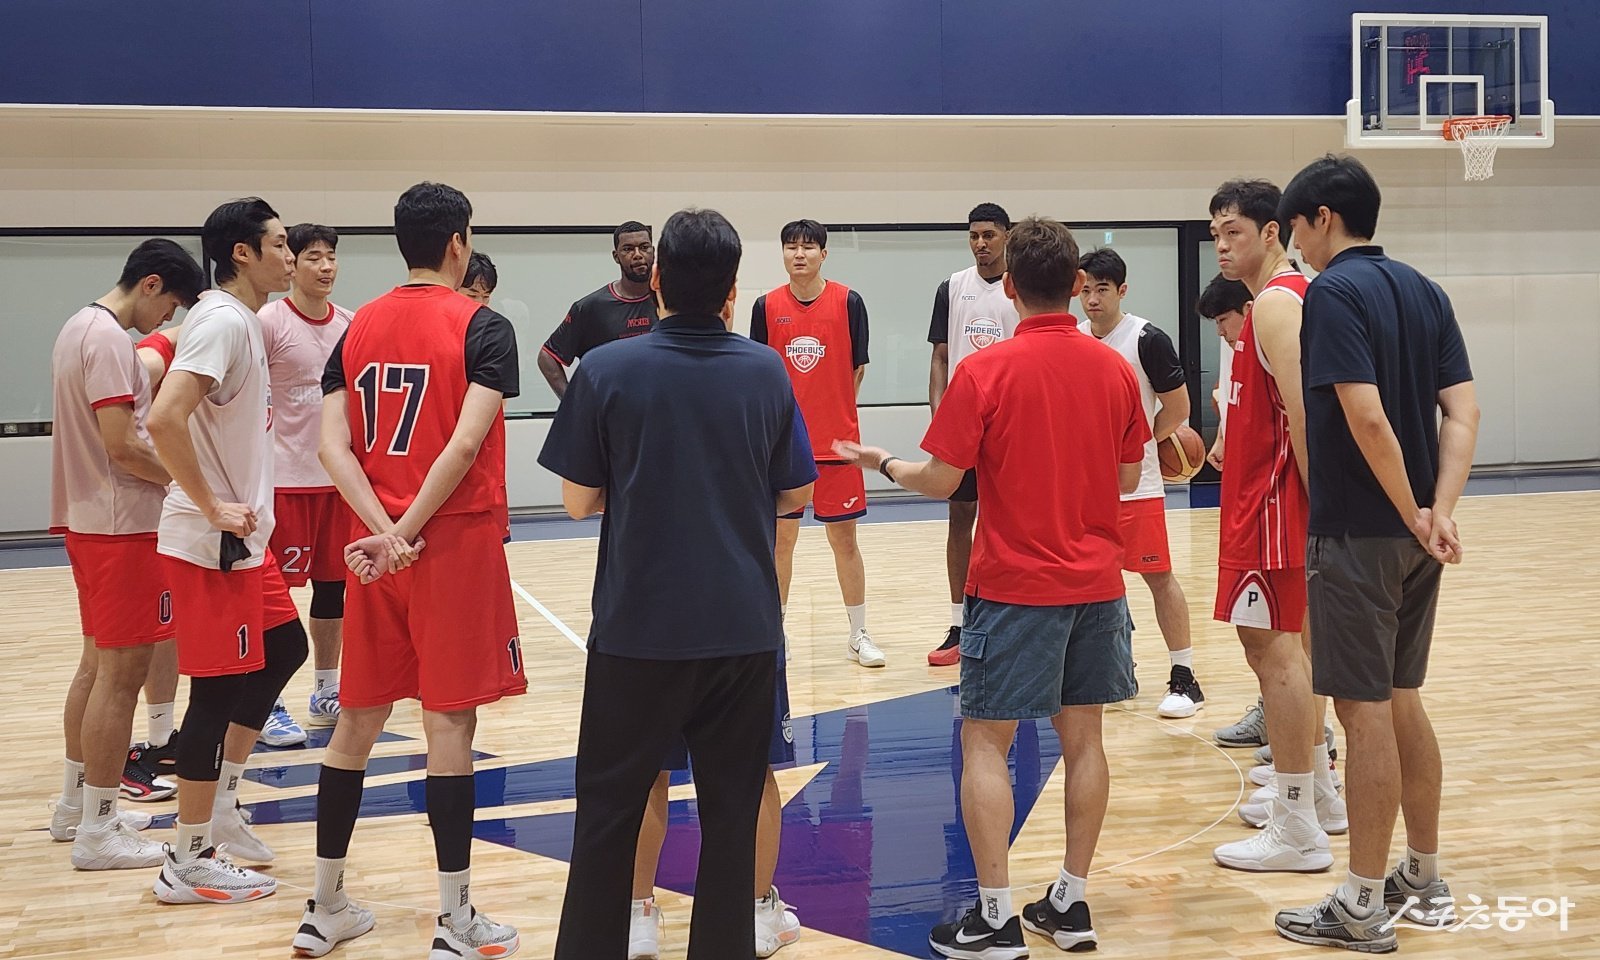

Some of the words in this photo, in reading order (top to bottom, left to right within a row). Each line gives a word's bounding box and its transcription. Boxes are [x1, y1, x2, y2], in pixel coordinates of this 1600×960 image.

[964, 325, 1002, 338] PHOEBUS
[787, 346, 824, 356] PHOEBUS
[353, 361, 431, 456] 17
[281, 546, 312, 573] 27
[1247, 590, 1259, 608] P
[236, 623, 249, 660] 1
[507, 636, 522, 675] 1
